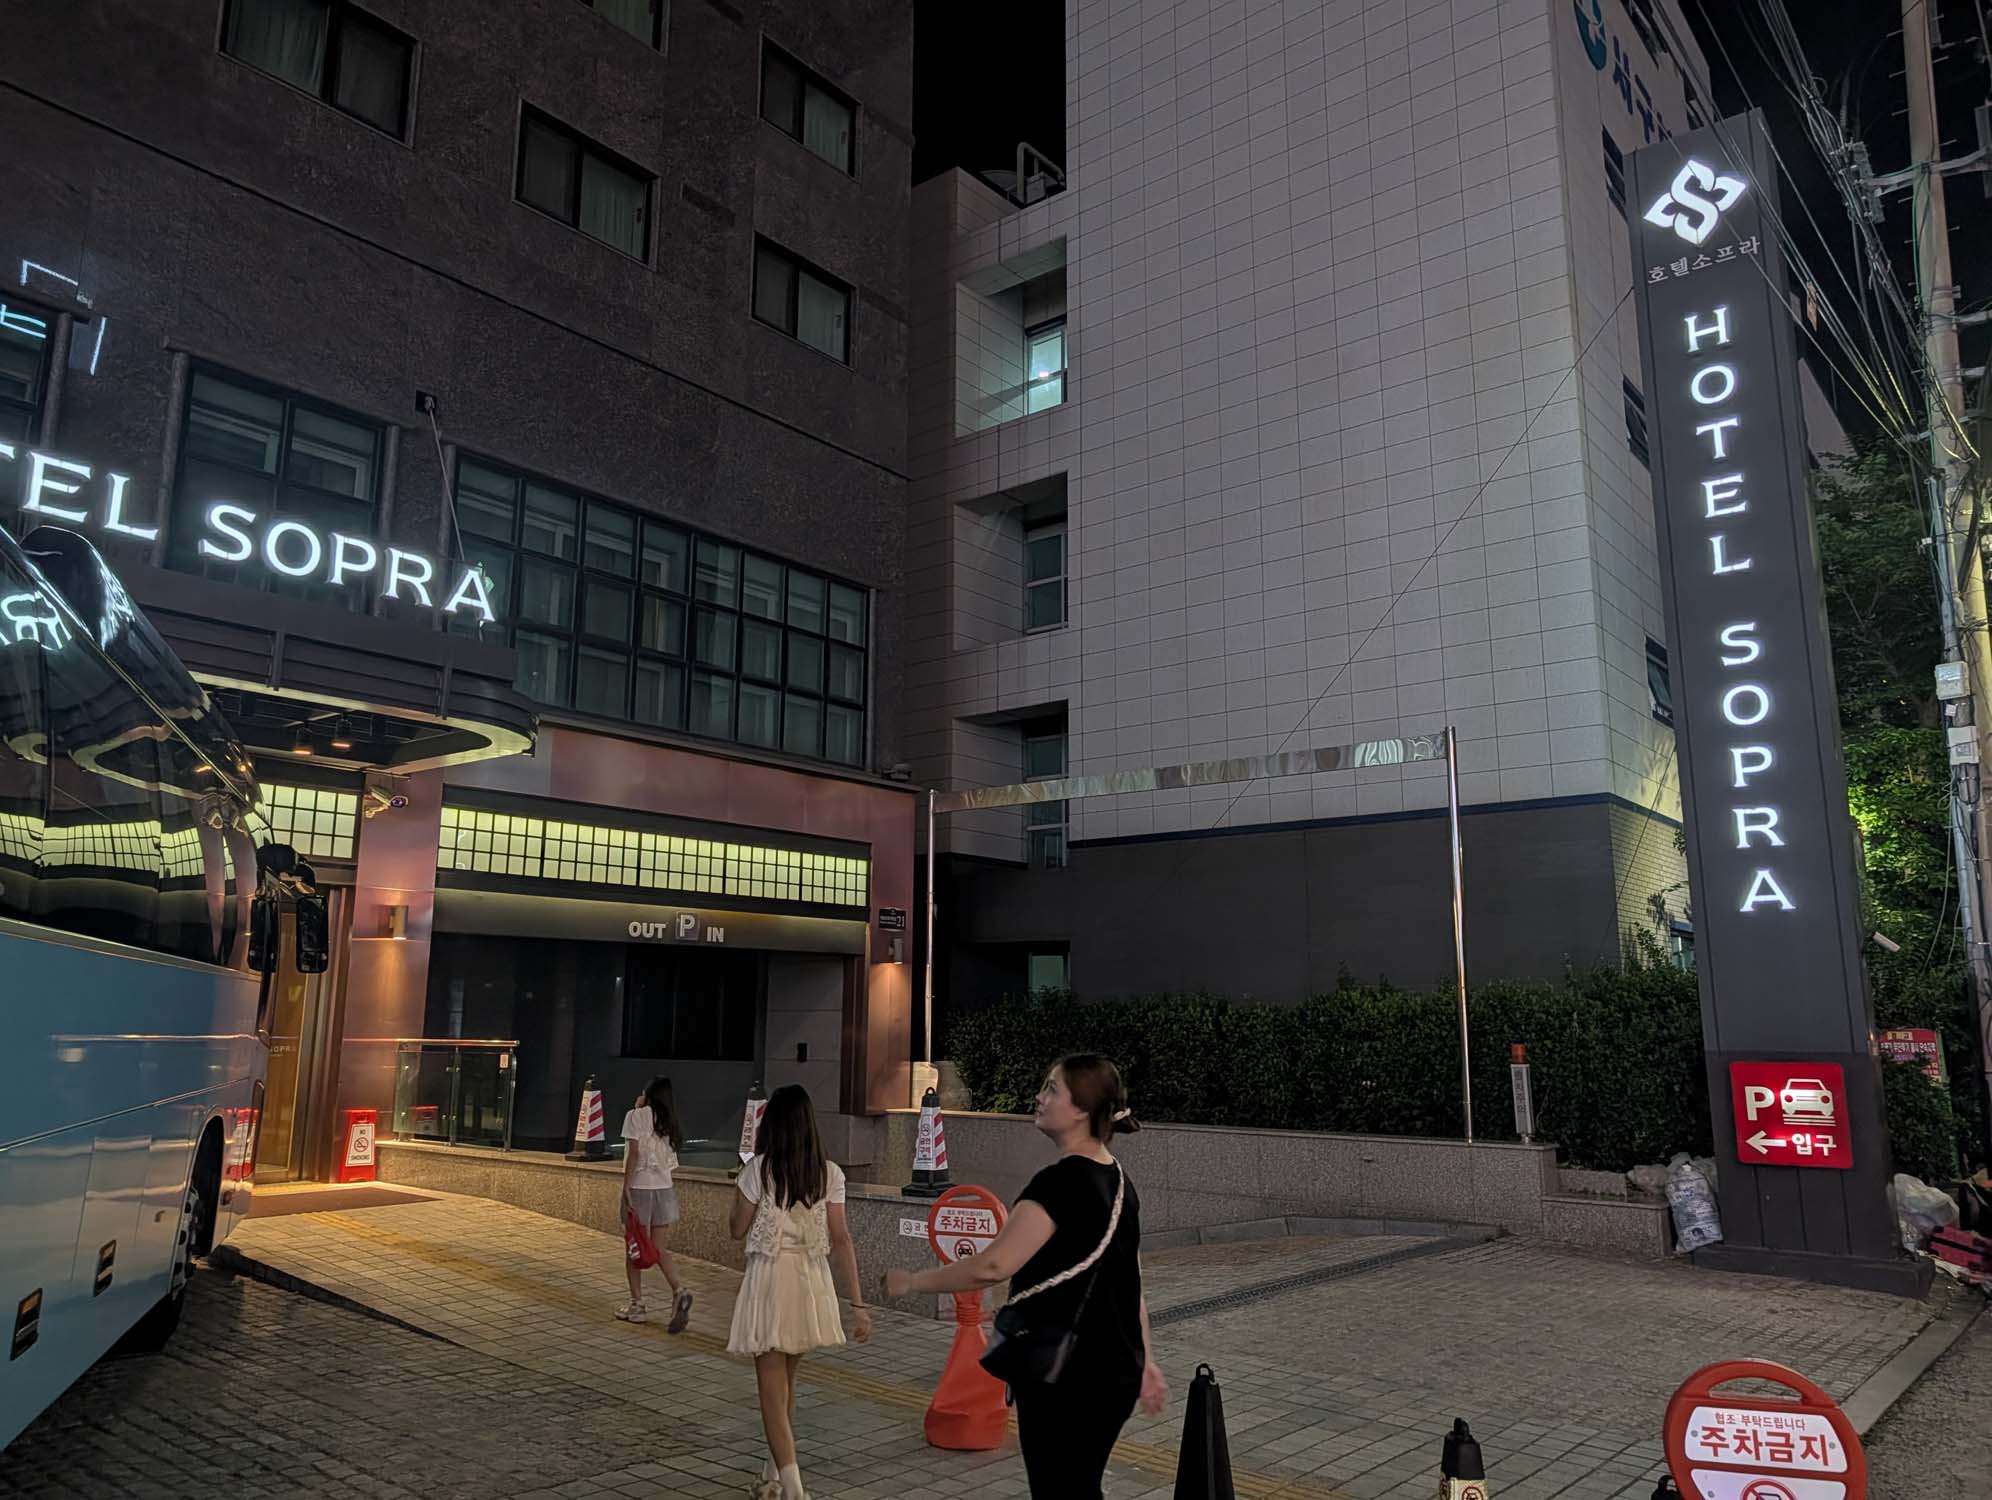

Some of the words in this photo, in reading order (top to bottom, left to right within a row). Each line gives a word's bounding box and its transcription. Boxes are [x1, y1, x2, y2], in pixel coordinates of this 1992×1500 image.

[0, 441, 158, 541] EL
[198, 502, 497, 623] SOPRA
[1683, 305, 1752, 575] HOTEL
[1719, 621, 1797, 912] SOPRA
[628, 921, 667, 939] OUT
[680, 914, 696, 937] P
[706, 926, 724, 942] IN
[896, 915, 905, 928] 21
[1744, 1085, 1776, 1121] P
[1791, 1133, 1838, 1157] 입구
[940, 1215, 990, 1233] 주차금지
[1715, 1411, 1737, 1425] 협조
[1741, 1413, 1807, 1432] 부탁드립니다
[1700, 1425, 1830, 1467] 주차금지
